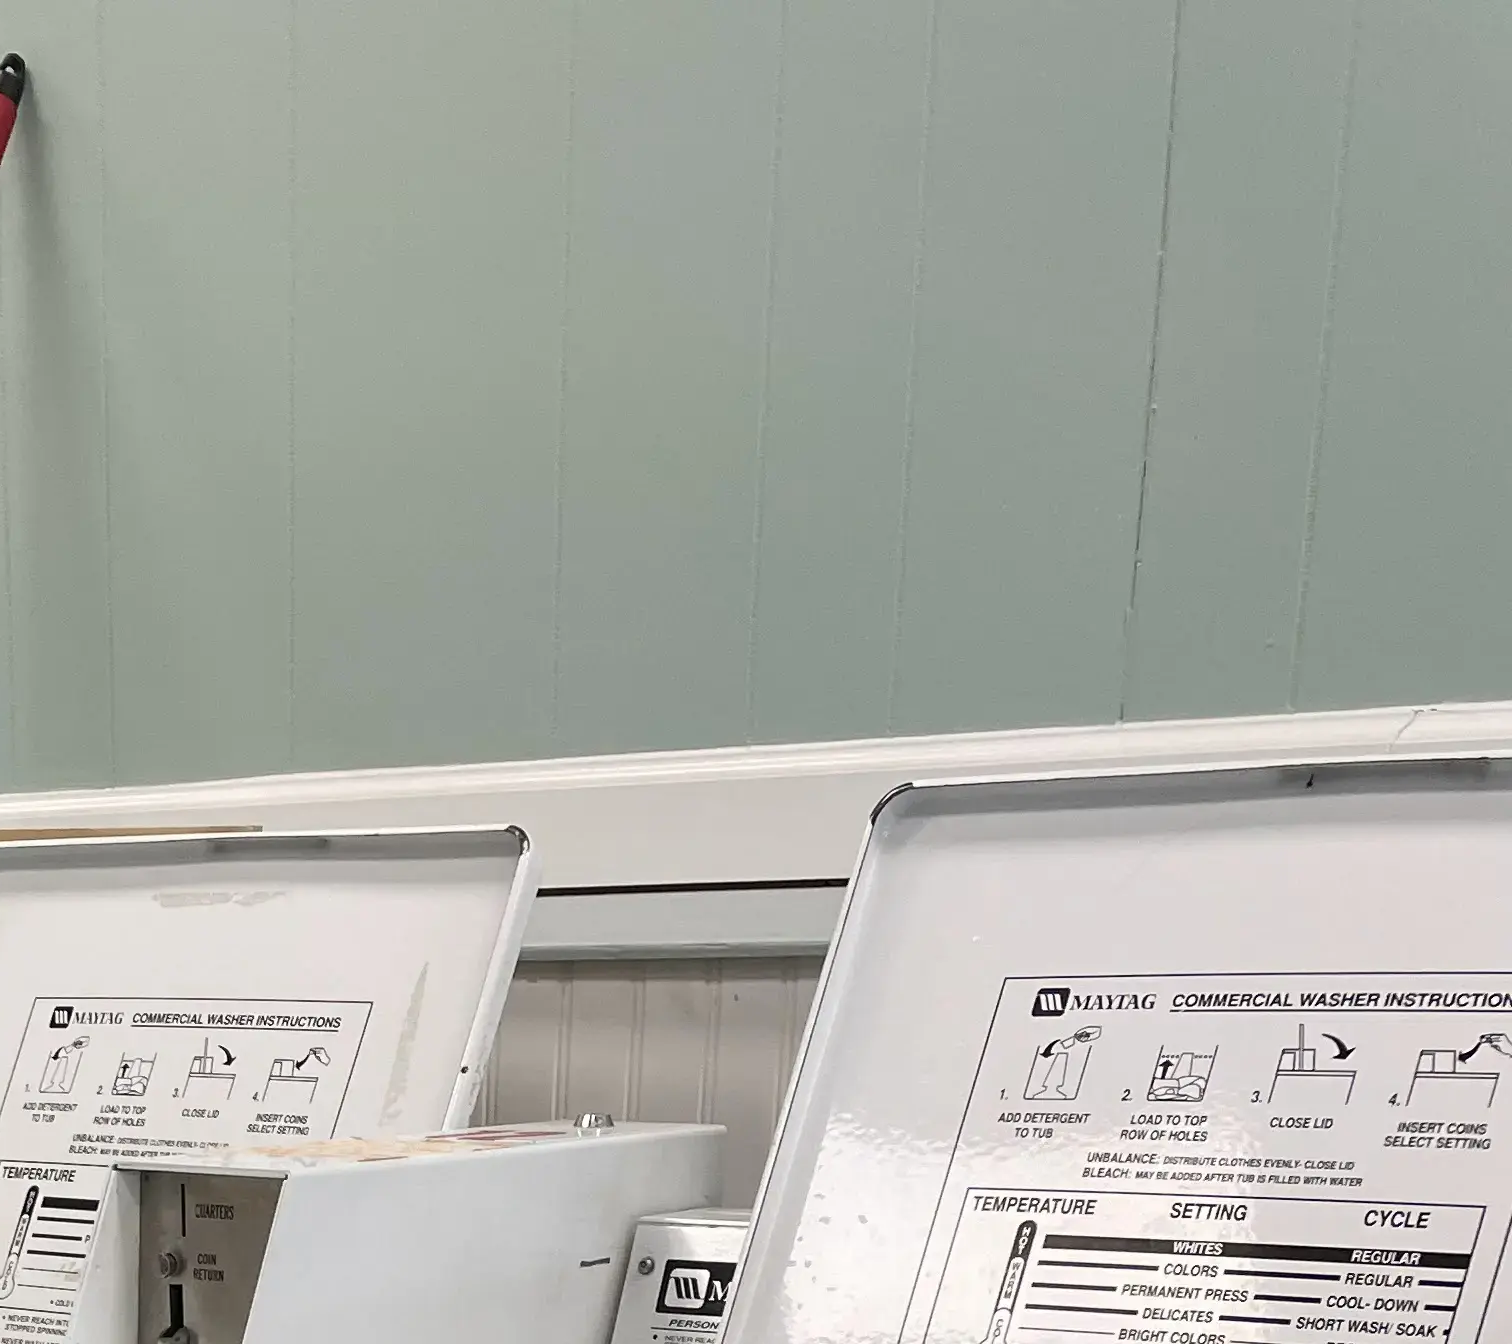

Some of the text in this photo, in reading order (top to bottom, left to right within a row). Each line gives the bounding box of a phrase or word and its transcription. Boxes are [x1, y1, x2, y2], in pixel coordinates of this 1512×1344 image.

[1070, 993, 1157, 1010] MAYTAG
[1172, 993, 1293, 1007] COMMERCIAL
[1299, 992, 1380, 1007] WASHER
[73, 1012, 342, 1029] MAYTAG COMMERCIAL WASHER INSTRUCTIONS
[999, 1089, 1009, 1100] 1.
[1251, 1091, 1262, 1104] 3.
[1388, 1093, 1401, 1107] 4.
[998, 1112, 1091, 1124] ADD DETERGENT
[1130, 1114, 1208, 1126] LOAD TO TOP
[1270, 1117, 1334, 1129] CLOSE LID
[247, 1125, 310, 1137] SELECT SETTING
[1015, 1127, 1053, 1139] TO TUB
[1120, 1130, 1209, 1142] ROW OF HOLES
[1397, 1122, 1488, 1135] INSERT COINS
[1384, 1136, 1491, 1150] SELECT SETTING
[1163, 1156, 1218, 1167] DISTRIBUTE
[1218, 1157, 1262, 1168] CLOTHES
[1304, 1160, 1336, 1170] CLOSE
[1338, 1161, 1356, 1171] LID
[2, 1166, 76, 1183] TEMPERATURE
[1082, 1167, 1363, 1188] BLEACH: MAY BE ADDED AFTER TUB IS FILLED WITH WATER
[195, 1203, 234, 1221] QUARTERS
[973, 1196, 1097, 1215] TEMPERATURE
[1170, 1202, 1248, 1222] SETTING
[1364, 1210, 1431, 1229] CYCLE
[1017, 1226, 1031, 1256] HOT
[1172, 1241, 1224, 1256] WHITES
[198, 1254, 217, 1266] COIN
[1351, 1250, 1422, 1265] REGULAR
[193, 1268, 225, 1282] RETURN
[1164, 1264, 1219, 1278] COLORS
[1003, 1262, 1021, 1299] WARM
[1345, 1273, 1414, 1288] REGULAR
[1121, 1284, 1249, 1303] PERMANENT PRESS
[1142, 1308, 1214, 1323] DELICATES
[1296, 1317, 1345, 1332] SHORT
[1396, 1323, 1438, 1338] SOAK
[1118, 1328, 1167, 1343] BRIGHT
